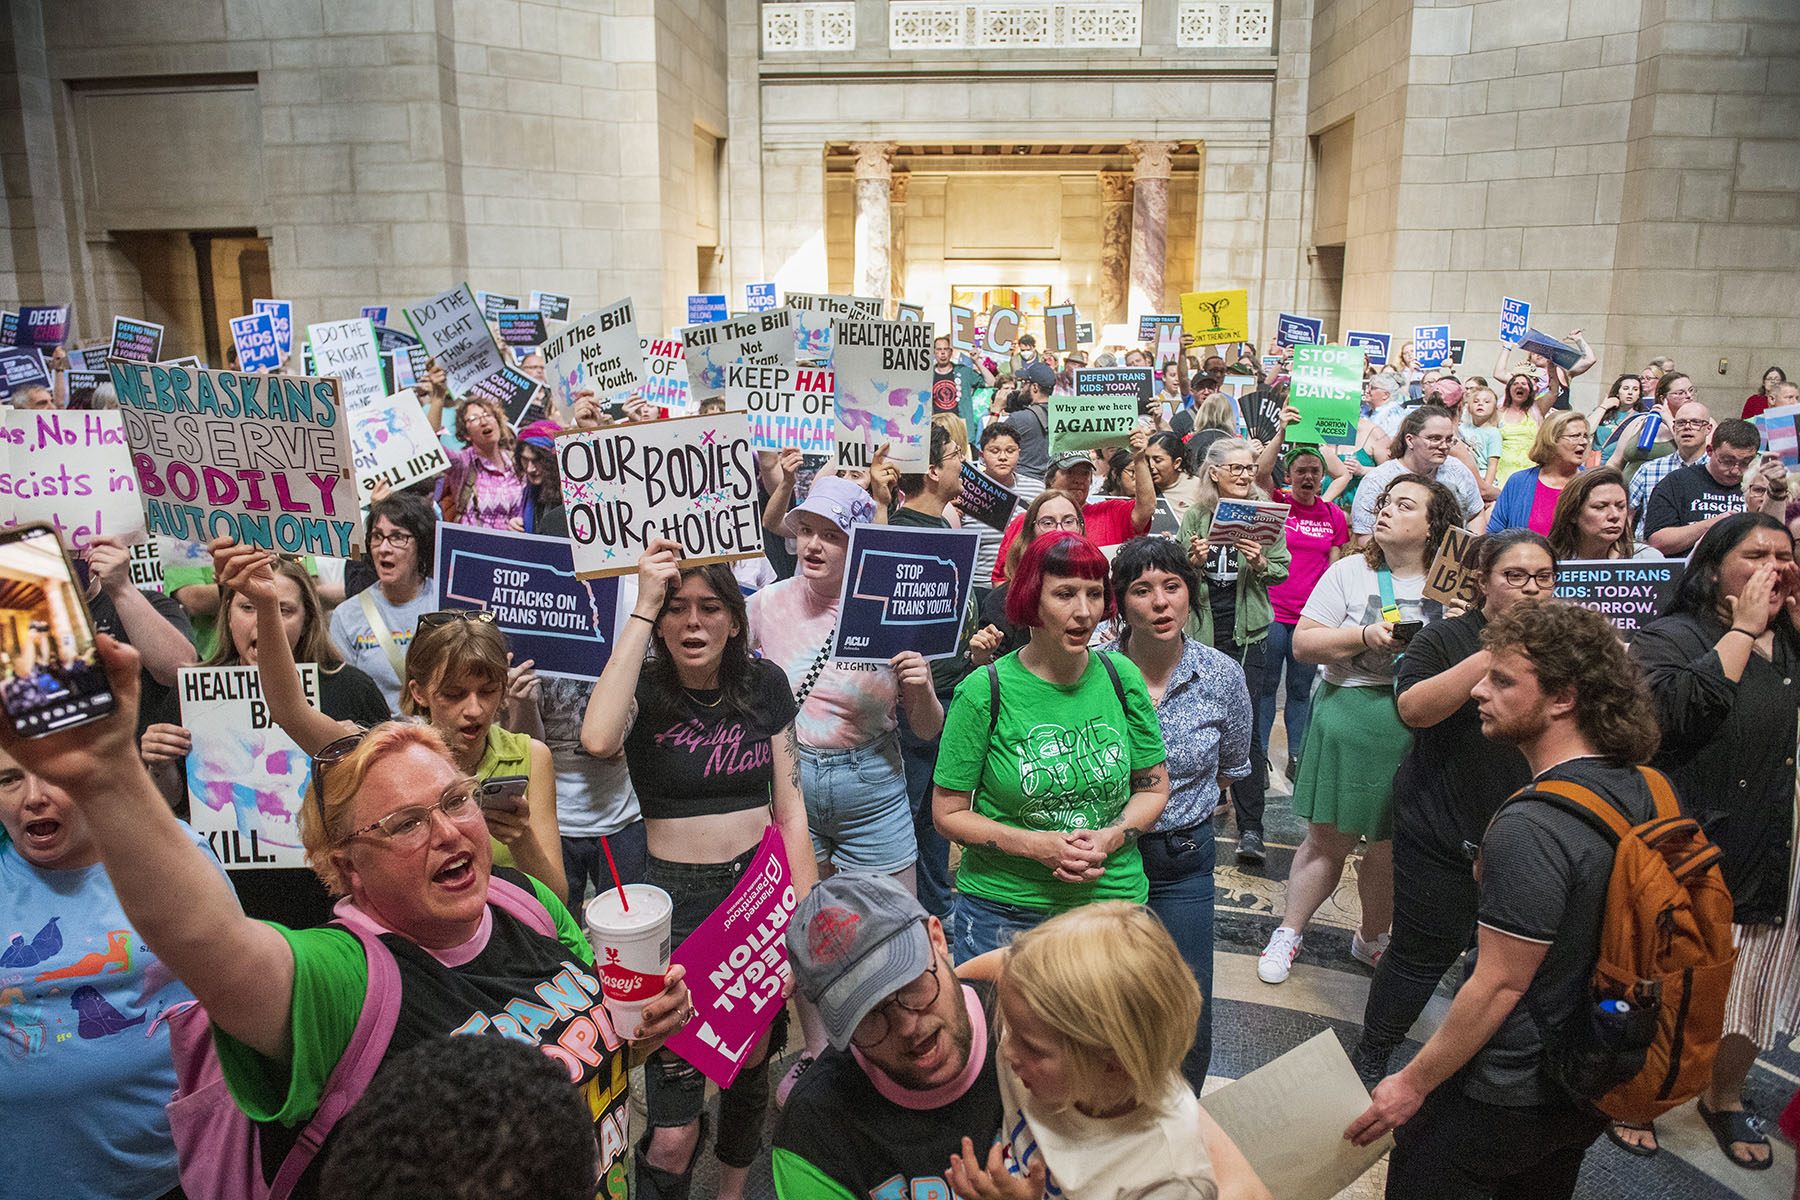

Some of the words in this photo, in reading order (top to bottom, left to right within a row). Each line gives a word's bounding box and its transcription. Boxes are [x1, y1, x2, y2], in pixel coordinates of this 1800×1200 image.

[748, 285, 767, 296] LET
[748, 296, 774, 306] KIDS
[412, 304, 437, 326] DO
[436, 290, 469, 313] THE
[785, 295, 813, 311] Kill
[818, 298, 848, 313] The
[1504, 300, 1522, 312] LET
[234, 319, 259, 336] LET
[1503, 311, 1526, 326] KIDS
[237, 331, 273, 349] KIDS
[316, 327, 338, 345] DO
[338, 321, 366, 340] THE
[432, 314, 473, 347] RIGHT
[544, 336, 564, 364] Kill
[567, 324, 596, 347] The
[600, 305, 632, 332] Bill
[685, 327, 717, 348] Kill
[722, 322, 756, 341] The
[761, 311, 789, 332] Bill
[838, 322, 932, 348] HEALTHCARE
[1416, 328, 1439, 340] LET
[1502, 322, 1526, 337] PLAY
[241, 344, 275, 363] PLAY
[325, 342, 369, 366] RIGHT
[435, 337, 473, 363] THING
[580, 343, 602, 362] Not
[741, 341, 763, 356] Not
[1416, 339, 1446, 350] KIDS
[882, 348, 931, 371] BANS
[1298, 349, 1348, 363] STOP
[1416, 350, 1447, 361] PLAY
[587, 356, 622, 377] Trans
[652, 358, 677, 376] OF
[1297, 365, 1334, 377] THE
[490, 374, 517, 396] ODAY,
[501, 367, 530, 390] TRANS
[598, 368, 638, 391] Youth.
[728, 366, 790, 390] KEEP
[1080, 373, 1115, 383] DEFEND
[1117, 372, 1146, 382] TRANS
[1080, 383, 1104, 393] KIDS:
[1105, 383, 1140, 393] TODAY,
[109, 362, 337, 428] NEBRASKANS
[479, 380, 512, 404] ORROW,
[1295, 383, 1351, 401] BANS.
[747, 391, 795, 413] OUT
[802, 394, 834, 415] OF
[1055, 404, 1079, 413] Why
[1112, 403, 1132, 411] here
[36, 414, 77, 449] No
[1054, 416, 1134, 434] AGAIN??
[1315, 420, 1347, 428] ABORTION
[1321, 428, 1346, 436] ACCESS
[120, 410, 340, 473] DESERVE
[406, 449, 445, 478] Kill
[561, 434, 645, 486] OUR
[642, 438, 752, 508] BODIES
[0, 463, 93, 499] scists
[109, 467, 134, 492] in
[135, 452, 340, 516] BODILY
[963, 477, 996, 505] TODAY,
[977, 477, 1008, 501] TRANS
[962, 490, 993, 513] RROW,
[1703, 493, 1725, 501] Ban
[1230, 511, 1276, 523] Freedom
[1300, 520, 1319, 528] SPEAK
[147, 499, 356, 559] AUTONOMY
[570, 499, 642, 549] OUR
[641, 500, 763, 560] CHOICE!
[1300, 526, 1311, 534] NO
[492, 568, 530, 587] STOP
[895, 563, 924, 580] STOP
[1614, 569, 1671, 582] TRANS
[491, 587, 554, 609] ATTACKS
[556, 593, 577, 611] ON
[893, 581, 936, 598] ATTACKS
[936, 582, 950, 597] ON
[1595, 585, 1659, 600] TODAY,
[490, 604, 539, 625] TRANS
[540, 610, 590, 630] YOUTH.
[892, 599, 925, 616] TRANS
[925, 599, 952, 616] YOUTH.
[1572, 602, 1658, 616] MORROW,
[844, 636, 870, 647] ACLU
[836, 661, 878, 672] RIGHTS
[654, 718, 747, 754] Alpha
[1054, 715, 1109, 757] LOVE
[704, 741, 772, 778] Male
[1020, 741, 1128, 800] QUEER
[198, 830, 276, 865] KILL.
[743, 886, 775, 922] Planned
[708, 884, 798, 991] ORTION
[600, 969, 643, 993] Casey's
[713, 932, 788, 1012] LEGAL
